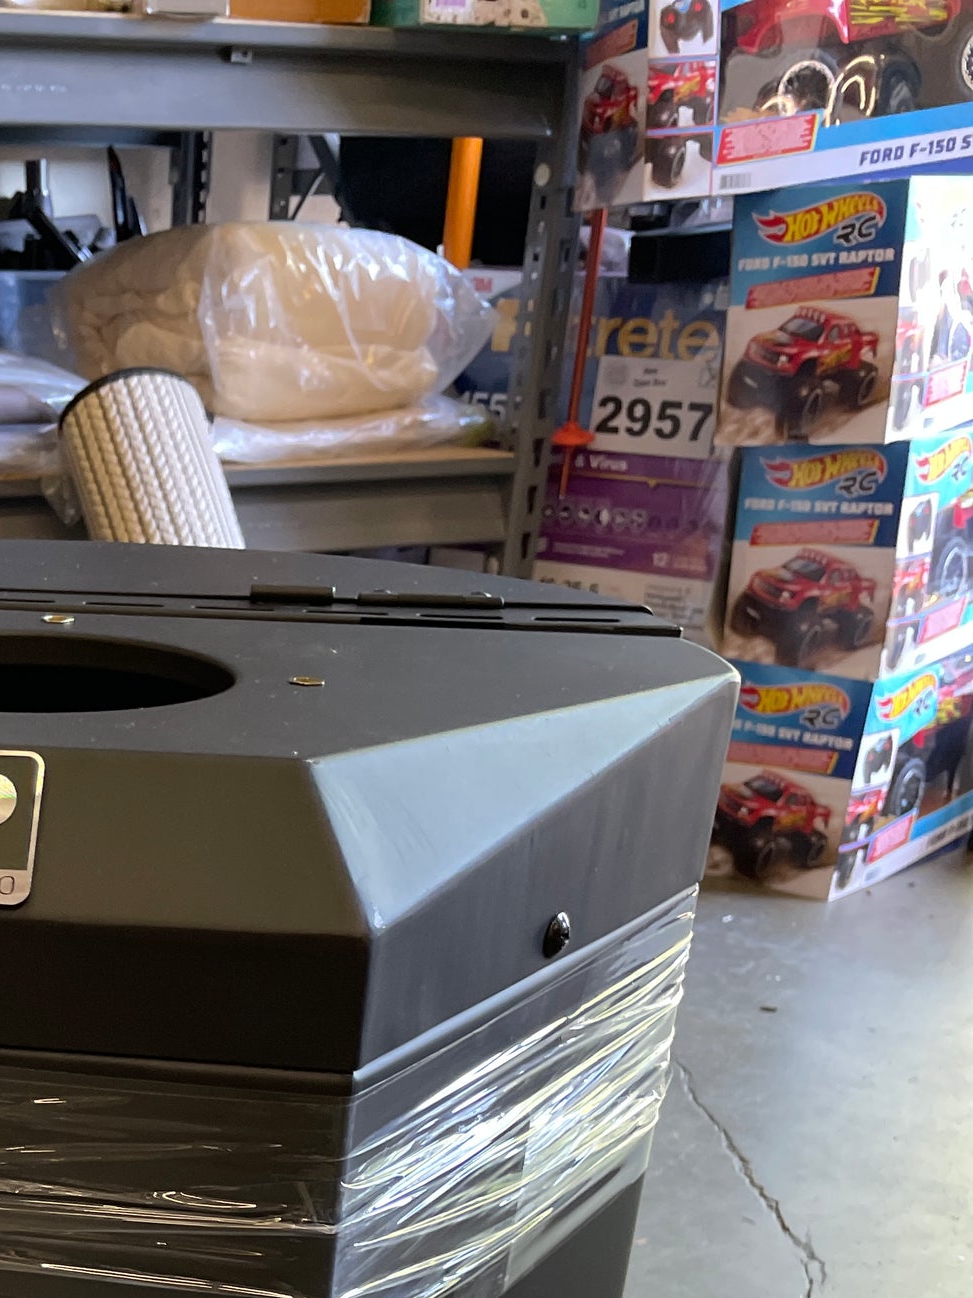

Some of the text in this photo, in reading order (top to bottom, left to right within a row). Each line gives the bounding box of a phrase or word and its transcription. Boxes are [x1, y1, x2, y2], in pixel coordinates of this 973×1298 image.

[859, 137, 957, 166] FORD F-150
[784, 194, 879, 243] HOT WHEELS
[835, 216, 877, 244] RC
[839, 248, 895, 265] RAPTOR
[587, 309, 719, 361] rete
[596, 395, 714, 442] 2957
[589, 455, 628, 472] Virus
